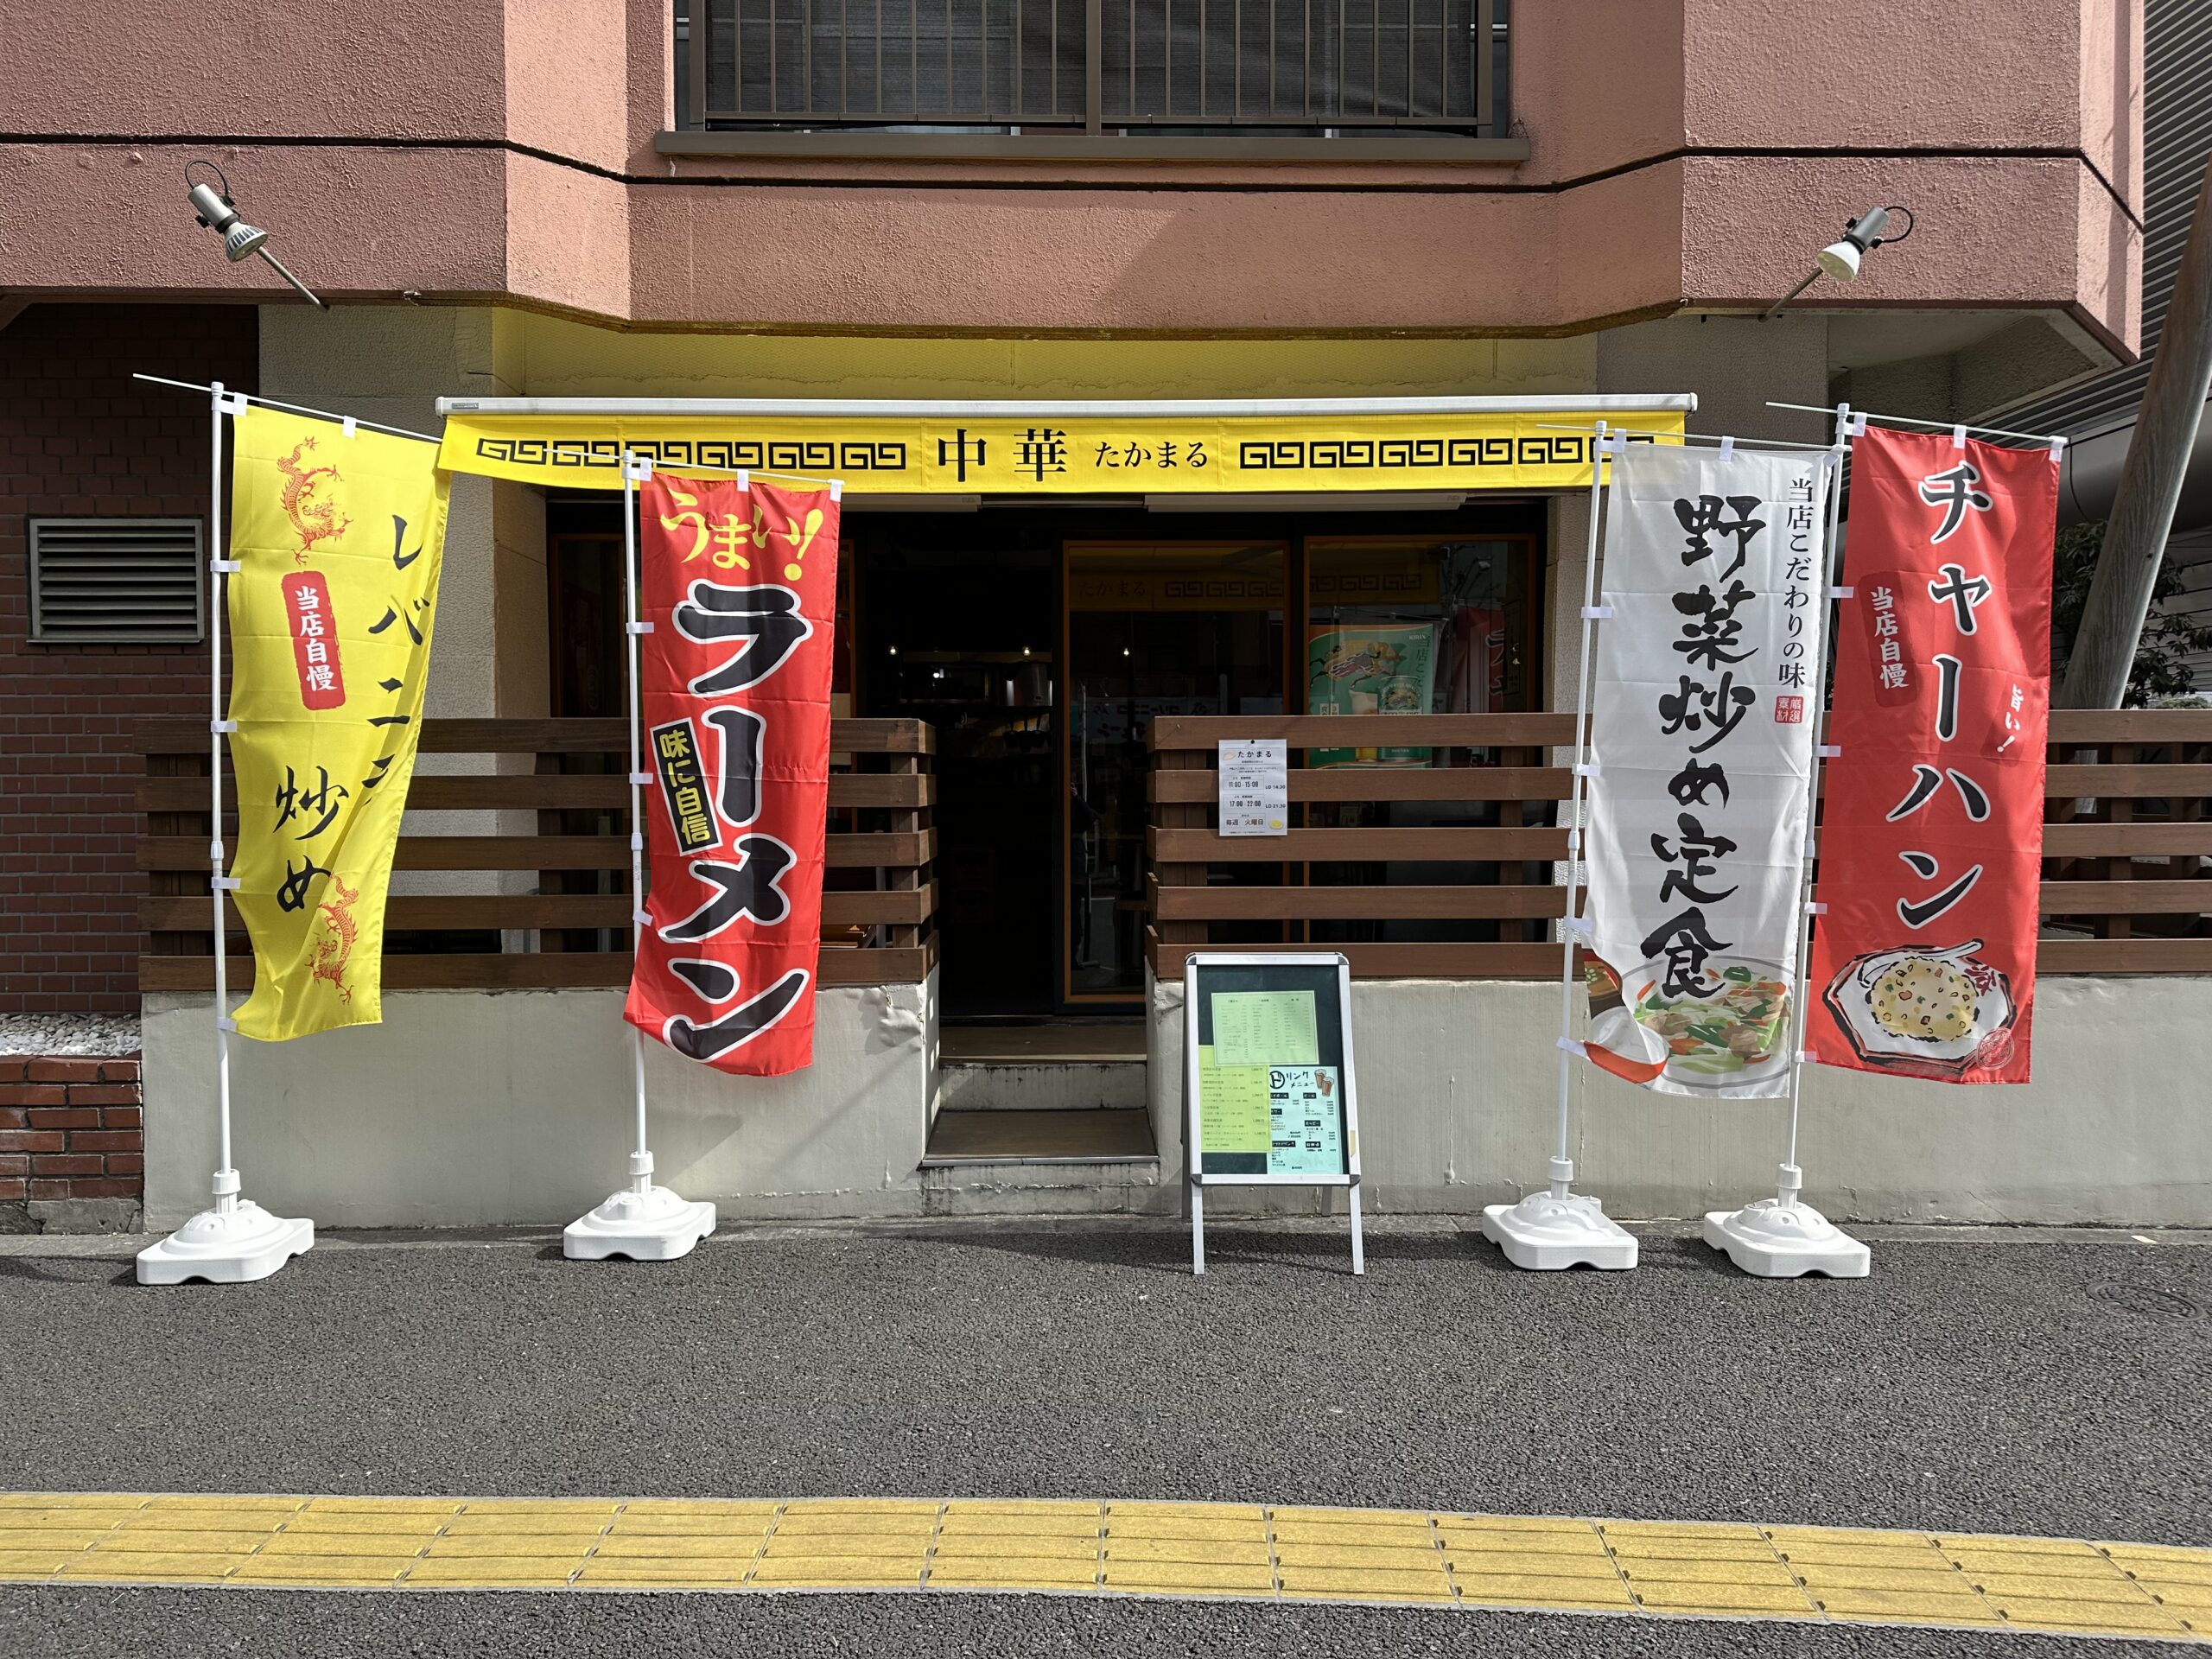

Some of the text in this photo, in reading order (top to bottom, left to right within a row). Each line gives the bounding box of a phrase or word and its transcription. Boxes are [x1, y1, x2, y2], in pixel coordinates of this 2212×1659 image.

[938, 428, 1208, 482] 中華 たかまる
[659, 486, 824, 582] うまい!
[1778, 477, 1813, 689] 当店こだわりの味
[294, 585, 338, 692] 当店自慢
[1869, 585, 1910, 690] 当店自慢
[658, 728, 711, 846] 味に自信
[1237, 750, 1272, 759] たかまる
[1640, 494, 1767, 999] 野菜炒め定食
[658, 577, 814, 1064] ラーメン
